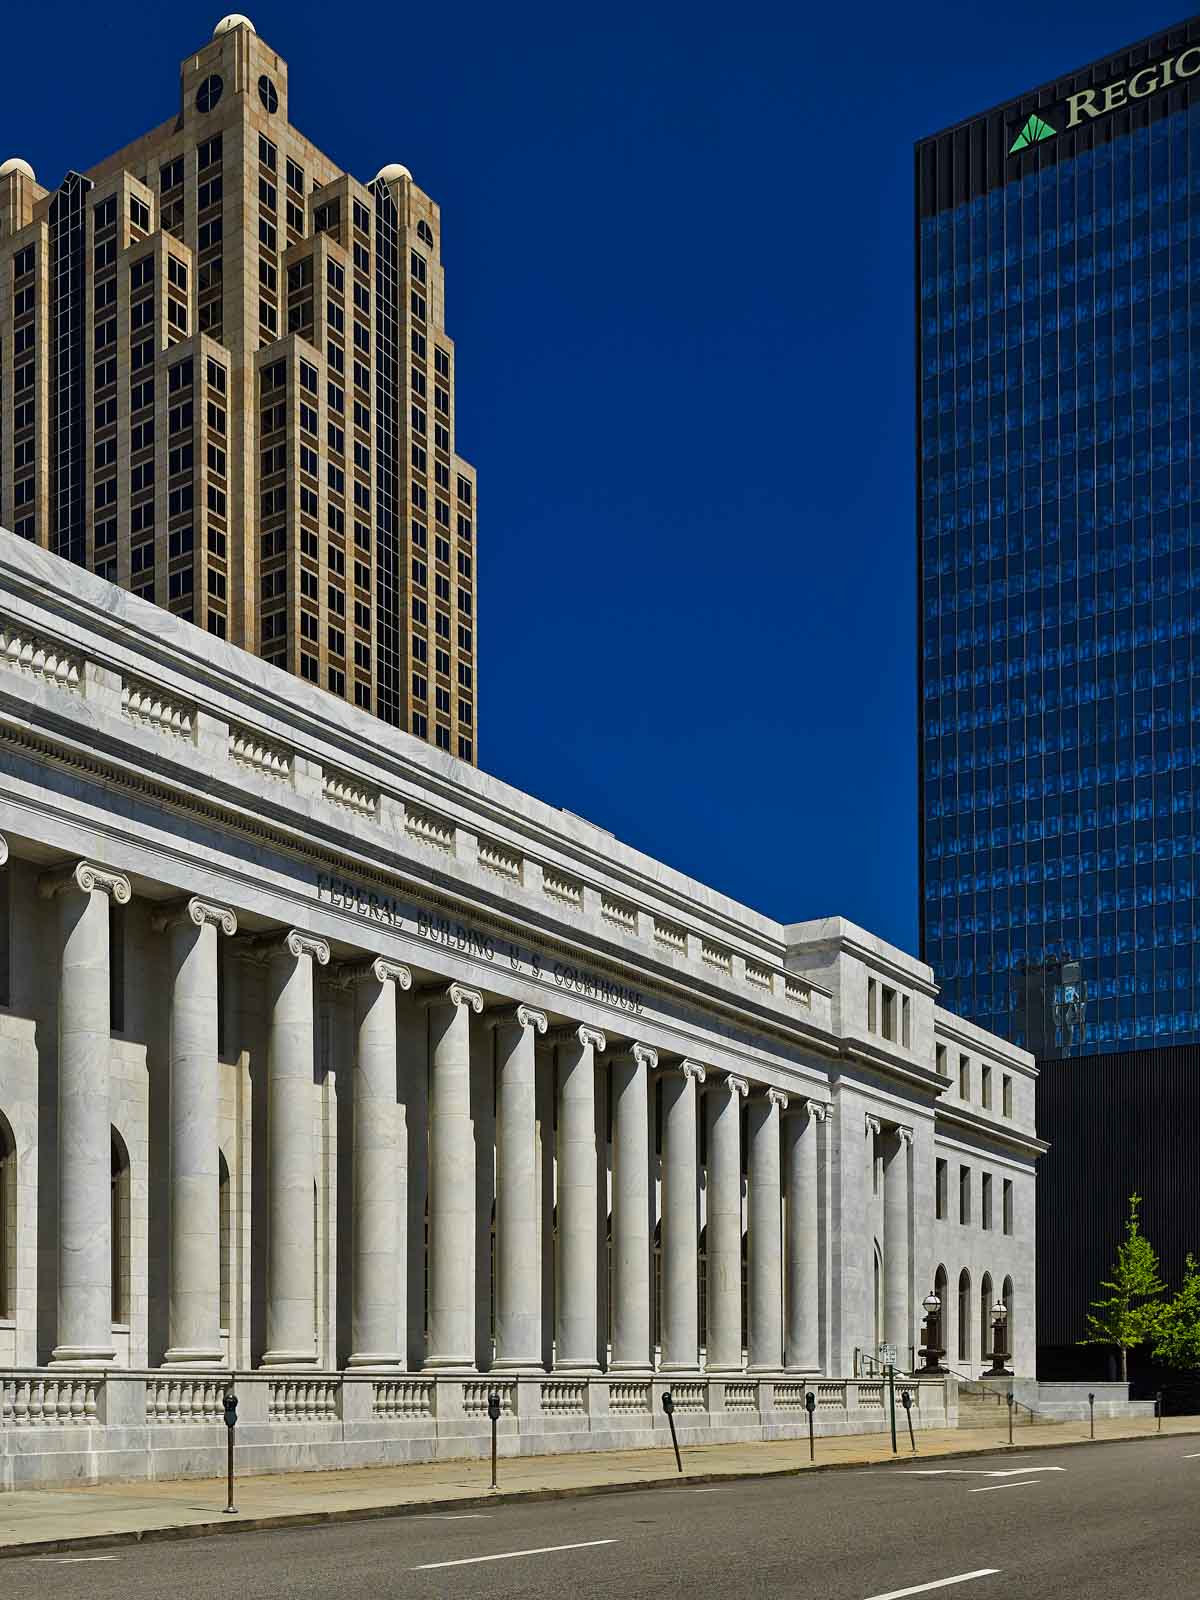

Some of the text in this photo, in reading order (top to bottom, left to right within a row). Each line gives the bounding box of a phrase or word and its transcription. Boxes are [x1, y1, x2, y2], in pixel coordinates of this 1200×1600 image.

[317, 873, 403, 928] FEDERAL
[417, 908, 494, 960] BUILDING
[554, 962, 643, 1014] COURTHOUSE
